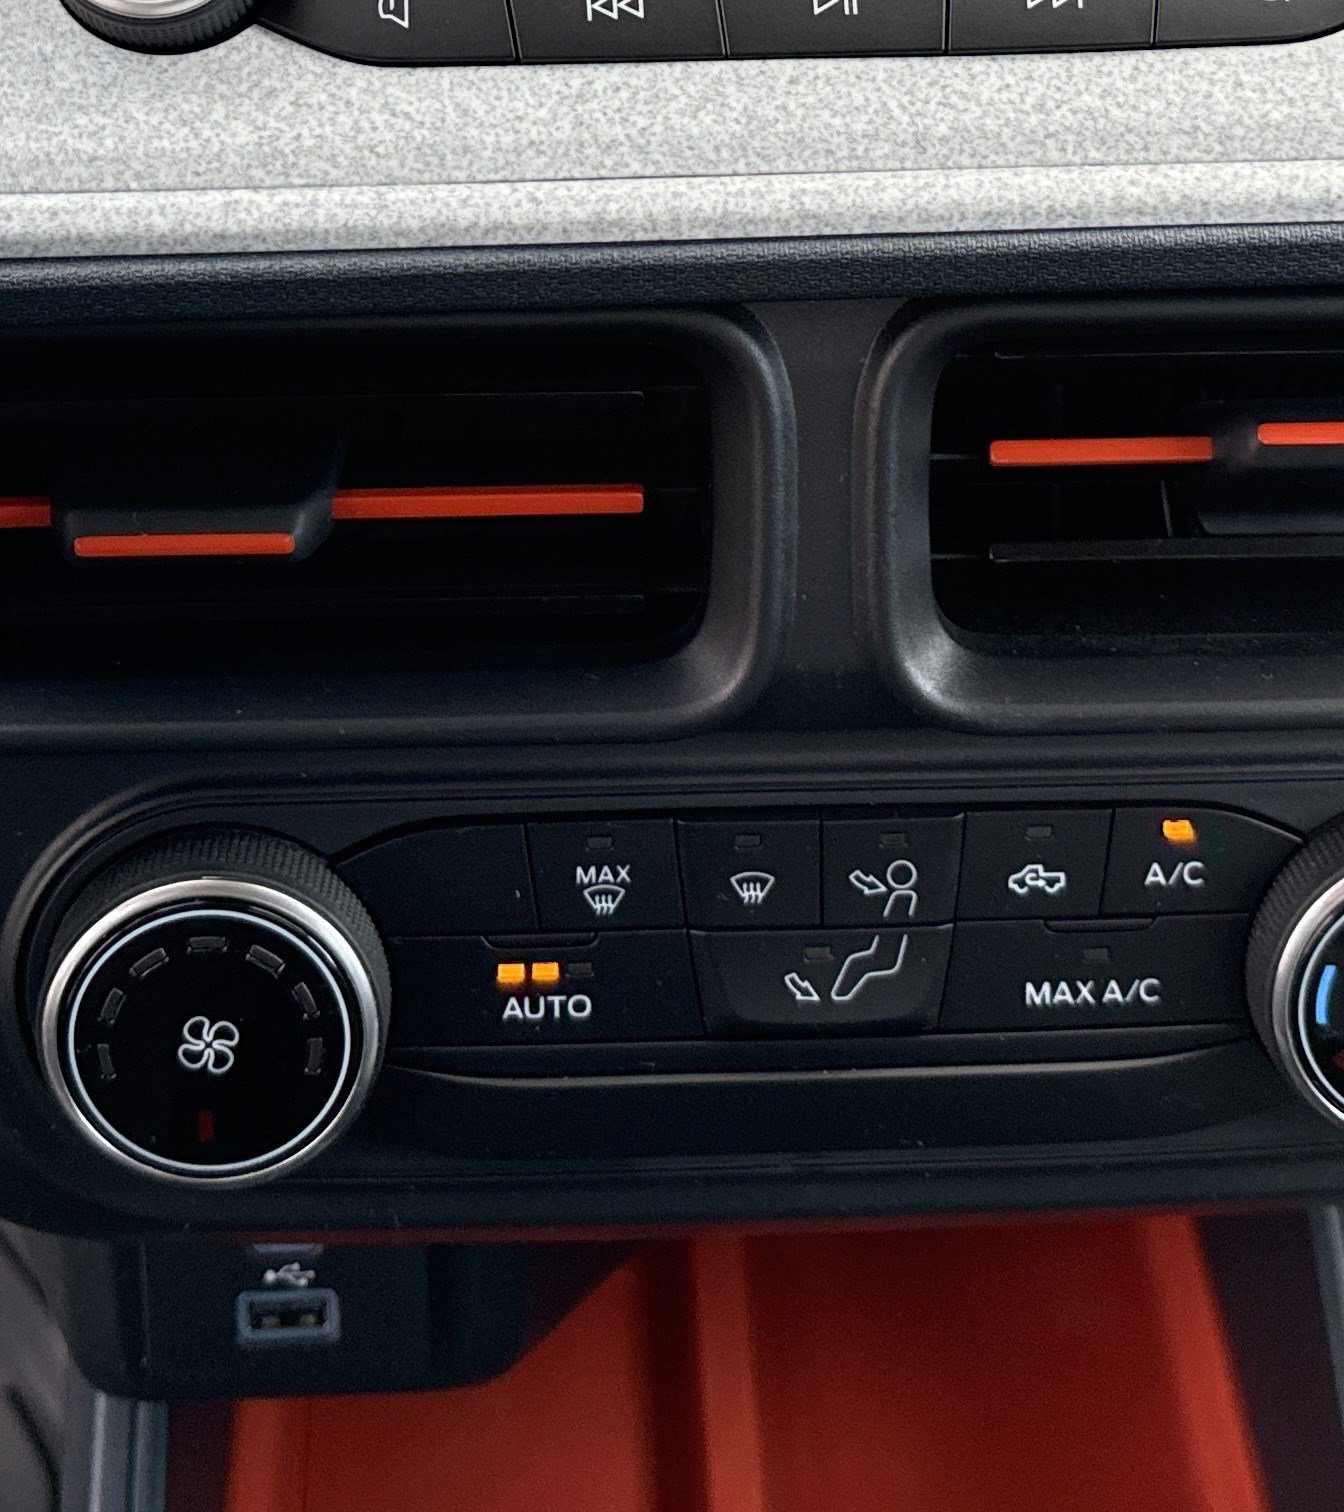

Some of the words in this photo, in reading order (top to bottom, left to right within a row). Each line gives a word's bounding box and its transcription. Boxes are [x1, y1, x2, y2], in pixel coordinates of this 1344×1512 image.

[575, 864, 632, 885] MAX
[1144, 860, 1205, 887] A/C
[1024, 980, 1096, 1007] MAX
[1101, 977, 1162, 1005] A/C
[502, 993, 593, 1021] AUTO
